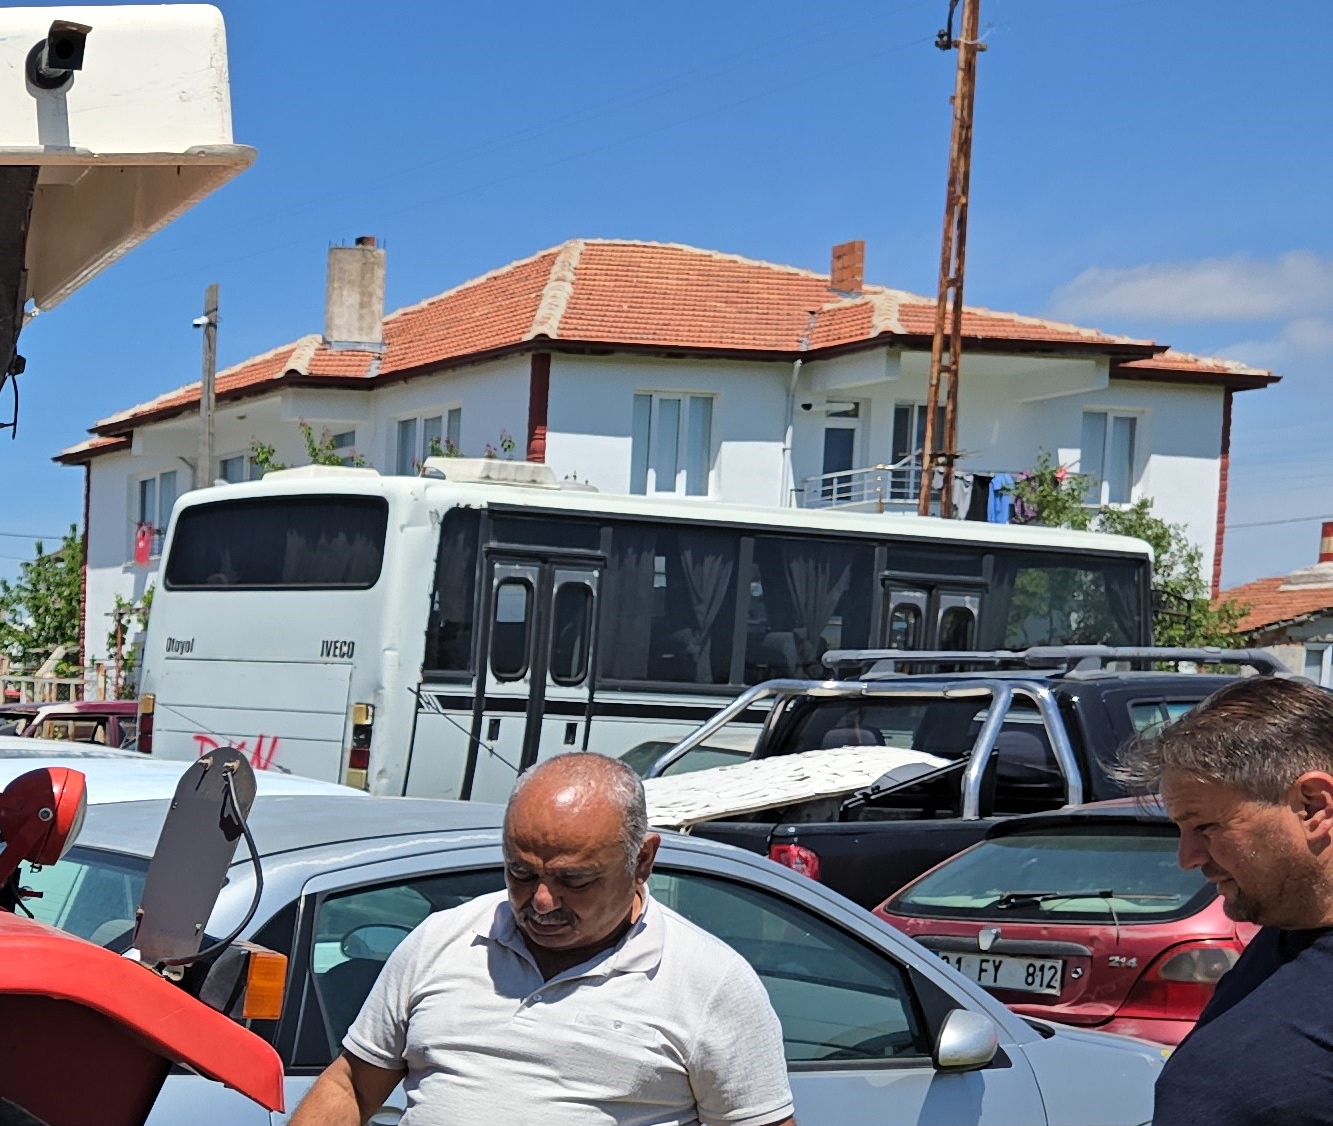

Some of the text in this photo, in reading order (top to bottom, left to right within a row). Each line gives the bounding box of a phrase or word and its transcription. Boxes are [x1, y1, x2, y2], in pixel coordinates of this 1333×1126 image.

[166, 637, 195, 655] Otoyol
[320, 640, 355, 658] IVECO
[1108, 956, 1137, 968] 214
[977, 958, 1003, 984] FY
[1025, 962, 1059, 990] 812
